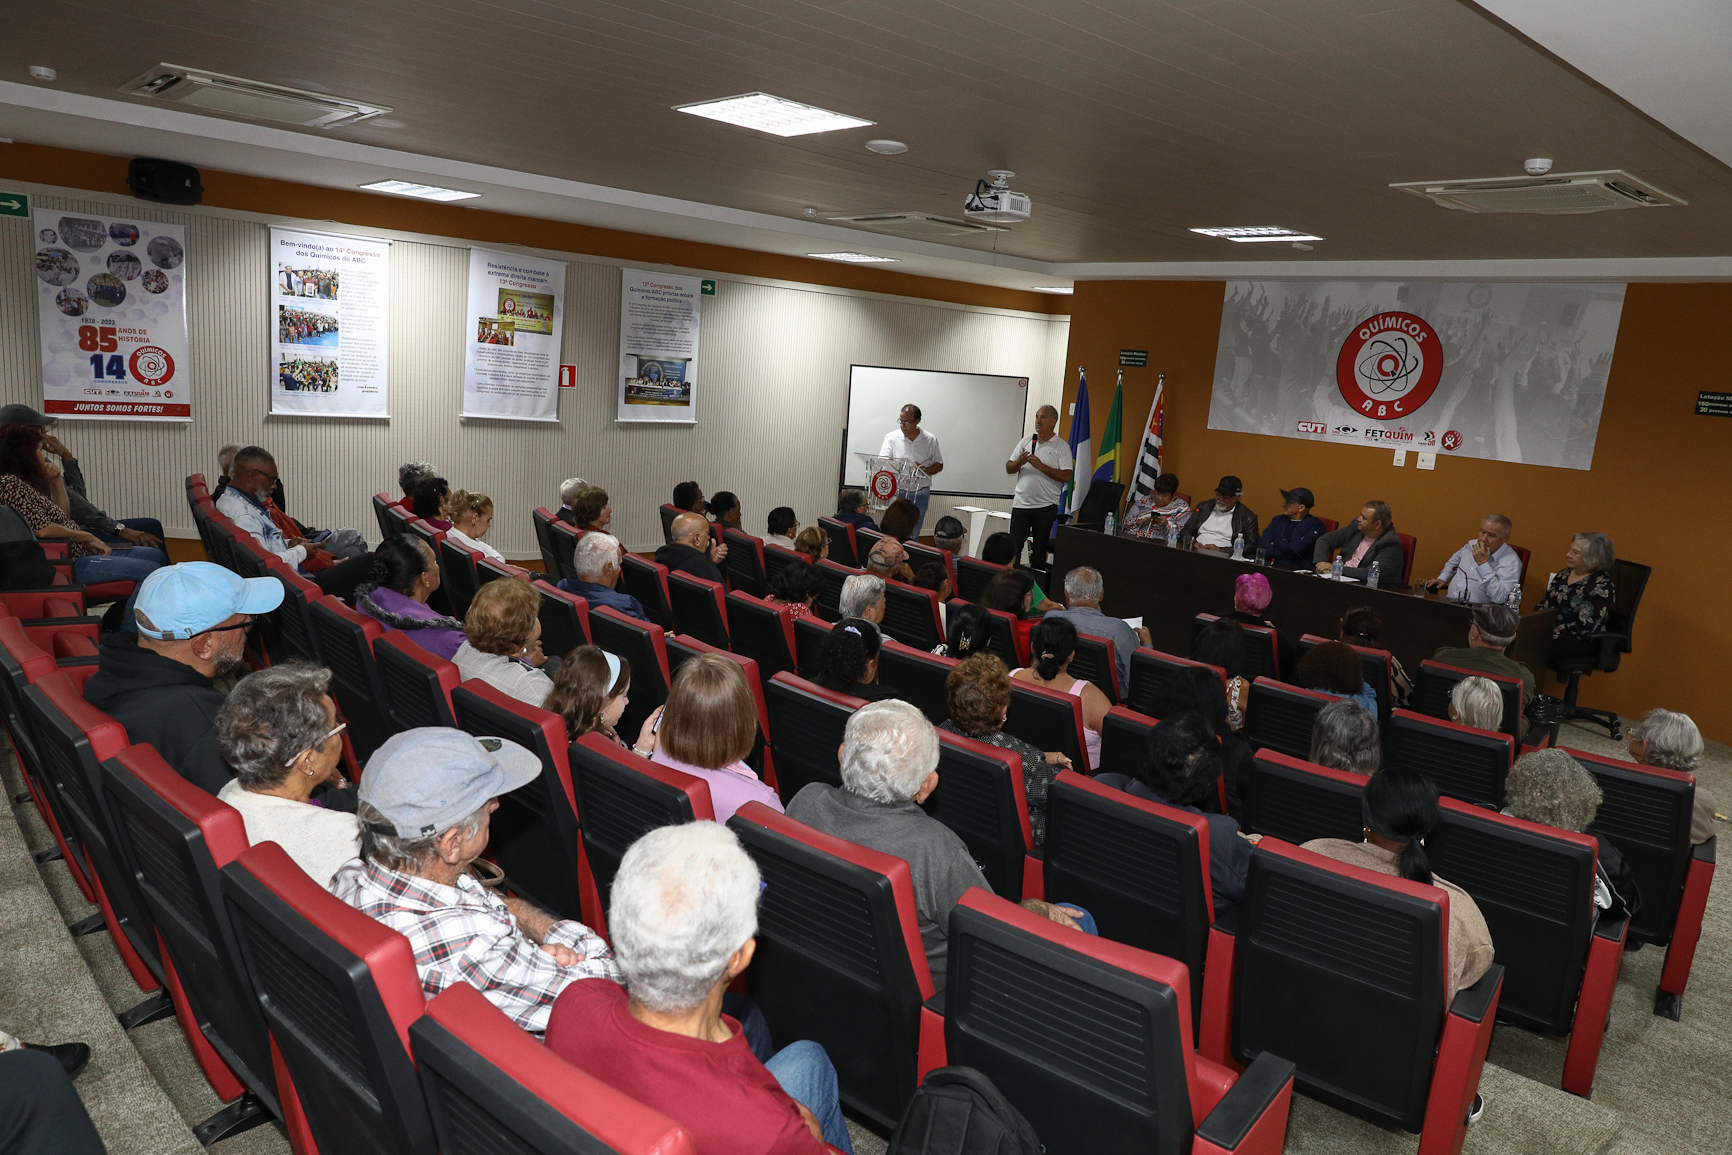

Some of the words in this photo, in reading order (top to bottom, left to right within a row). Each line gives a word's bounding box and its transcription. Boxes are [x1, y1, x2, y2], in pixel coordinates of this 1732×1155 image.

[280, 240, 324, 252] Bem-vindo(a)
[346, 249, 381, 258] Congresso
[487, 270, 509, 278] extrema
[510, 272, 527, 280] direita
[523, 269, 545, 277] combate
[508, 280, 537, 289] Congresso
[1359, 315, 1428, 343] QUÍMICOS
[78, 325, 118, 353] 85
[136, 346, 167, 358] QUÍMICOS
[90, 353, 126, 380] 14
[74, 403, 105, 412] JUNTOS
[105, 404, 133, 412] SOMOS
[133, 405, 164, 413] FORTES!
[1361, 399, 1404, 417] ABC
[1297, 422, 1325, 433] CUT
